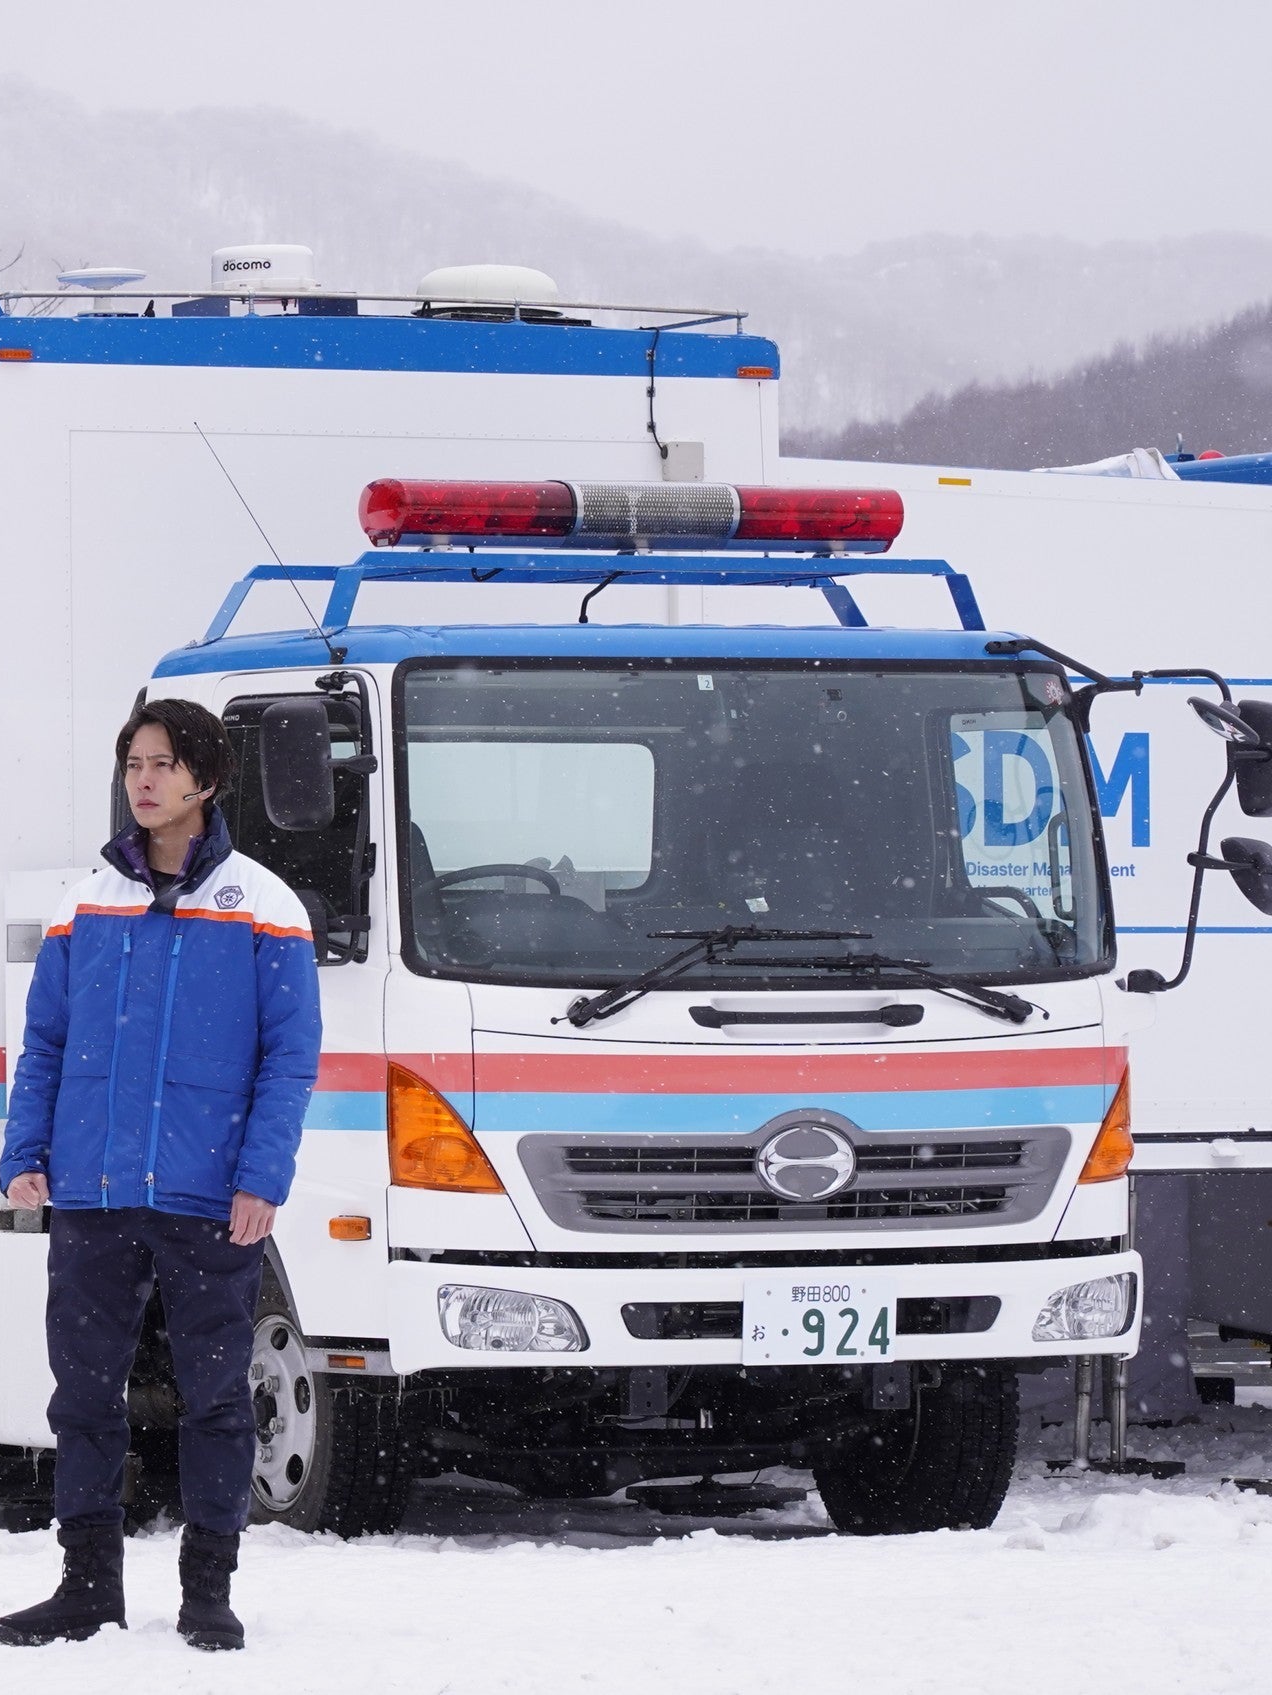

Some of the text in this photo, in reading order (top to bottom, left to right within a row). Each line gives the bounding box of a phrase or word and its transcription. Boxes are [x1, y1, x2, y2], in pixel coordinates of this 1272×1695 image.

[222, 260, 272, 272] docomo
[966, 861, 1029, 877] Disaster
[751, 1324, 766, 1342] お
